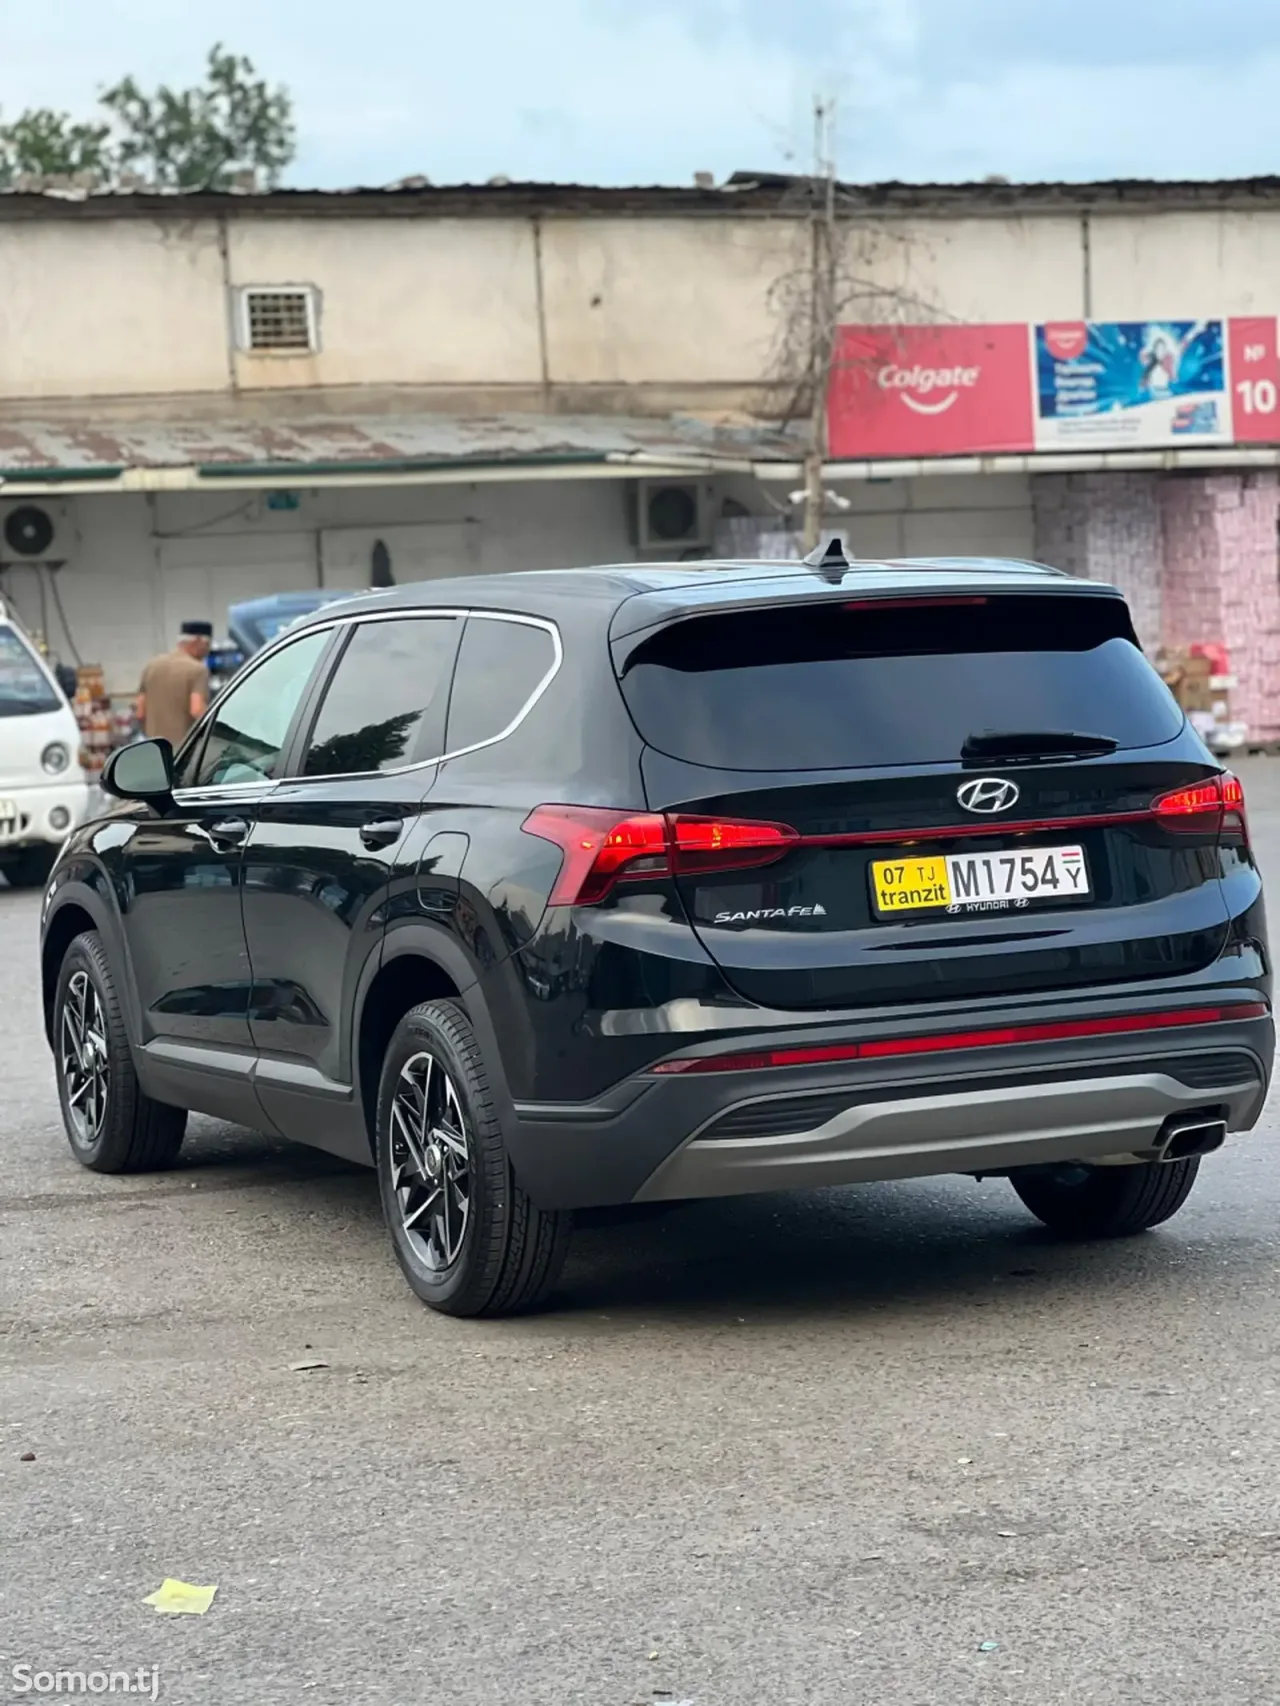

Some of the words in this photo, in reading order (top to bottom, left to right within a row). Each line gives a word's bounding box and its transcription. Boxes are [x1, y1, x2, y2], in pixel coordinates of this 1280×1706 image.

[878, 364, 980, 393] Colgate
[1236, 379, 1277, 414] 10
[883, 866, 905, 885] 07
[917, 866, 936, 882] TJ
[952, 855, 1059, 898] M1754
[1066, 867, 1082, 888] Y
[881, 883, 946, 906] tranzit
[966, 900, 1009, 912] HYUNDAI
